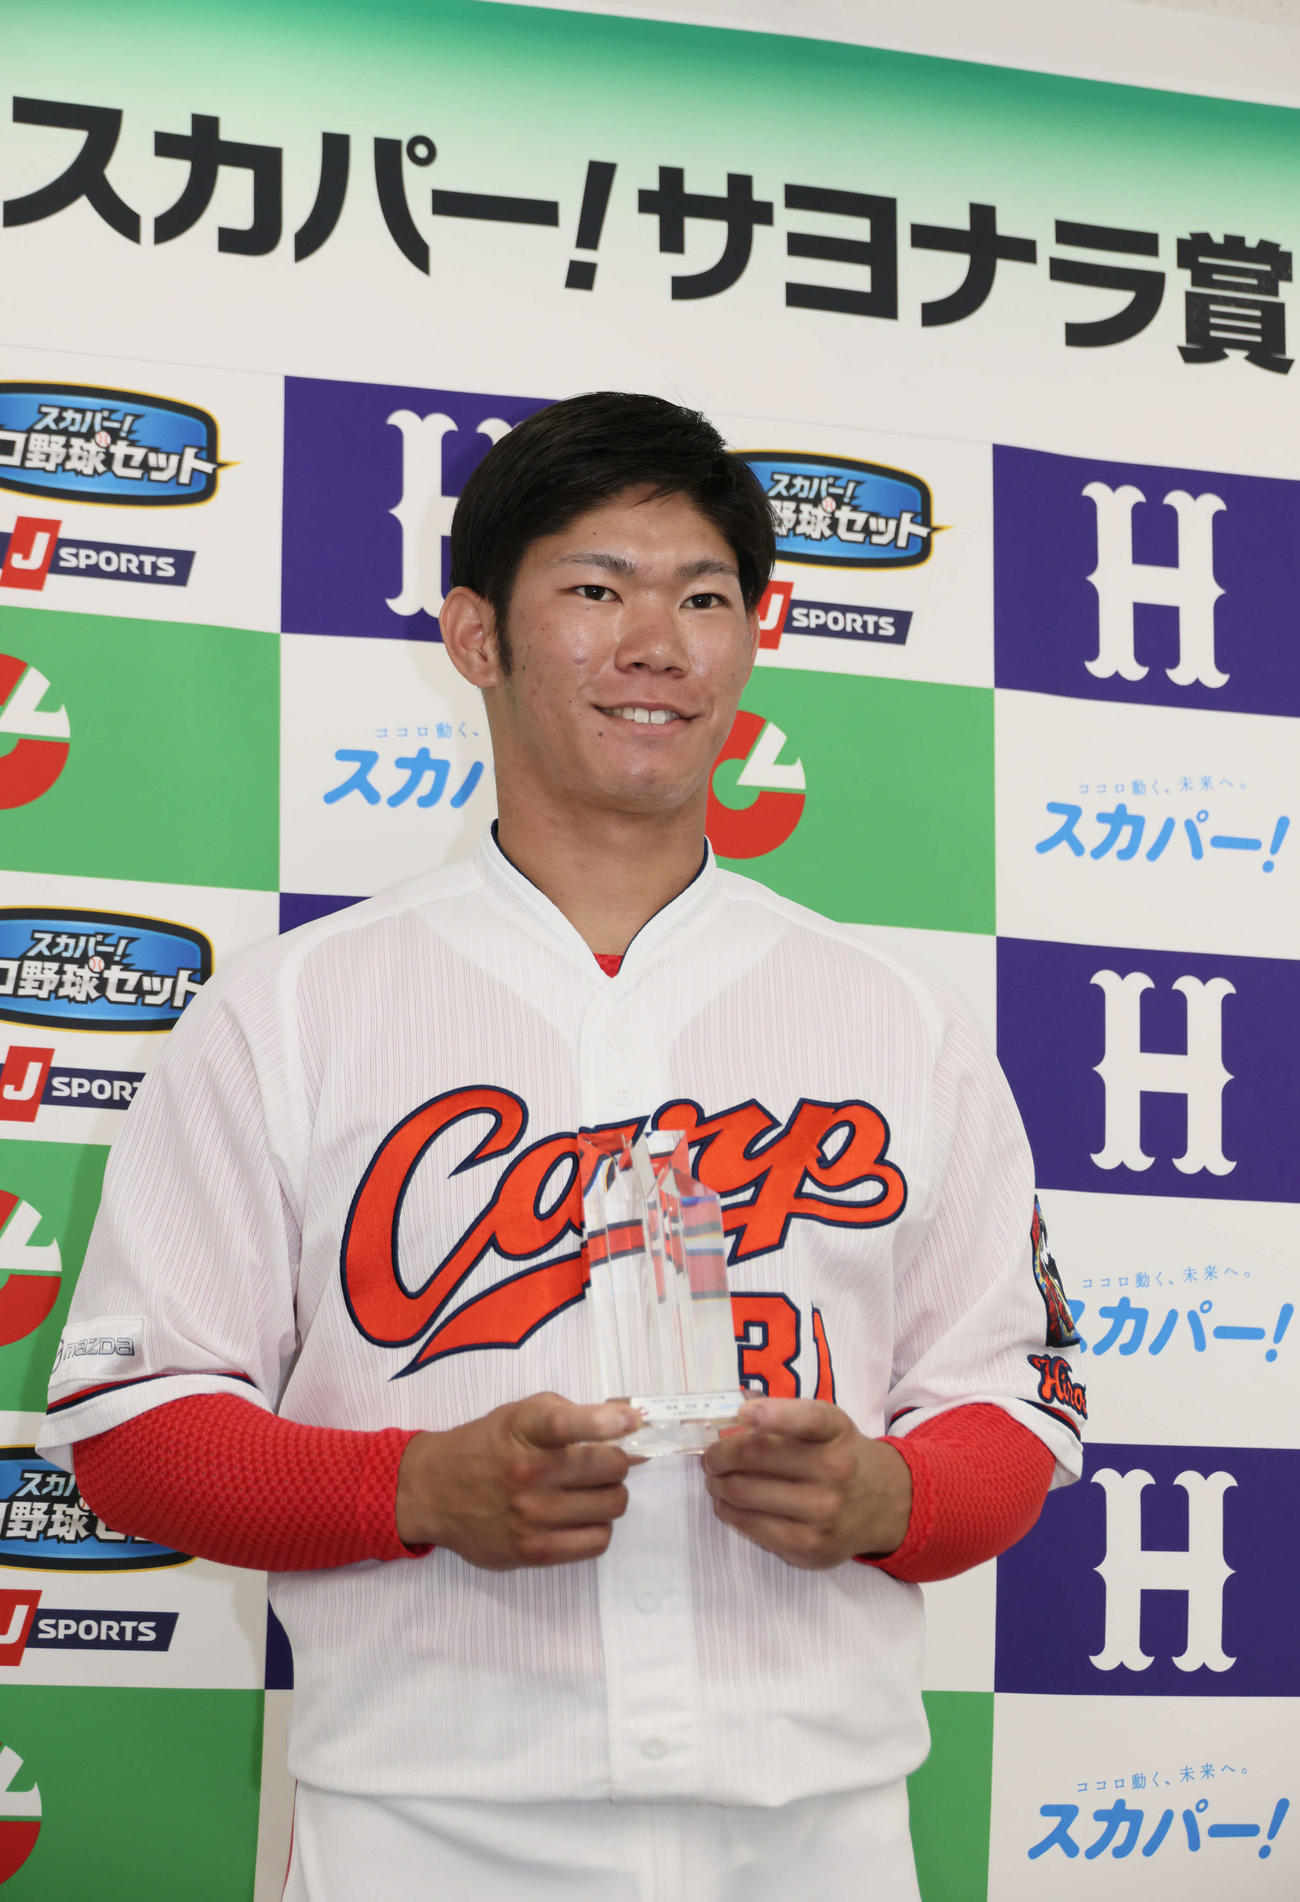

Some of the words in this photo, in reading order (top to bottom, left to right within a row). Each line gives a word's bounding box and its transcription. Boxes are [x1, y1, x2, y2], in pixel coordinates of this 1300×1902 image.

[33, 405, 136, 437] スカパー!
[767, 473, 857, 503] スカパー!
[10, 531, 51, 571] J
[58, 546, 176, 578] SPORTS
[1081, 481, 1231, 688] H
[791, 607, 896, 637] SPORTS
[1035, 801, 1291, 874] スカパー!
[26, 932, 131, 962] スカパー!
[2, 1061, 44, 1101] J
[51, 1076, 143, 1102] SPOR
[1089, 969, 1238, 1176] H
[1088, 1467, 1239, 1673] H
[37, 1617, 157, 1643] SPORTS
[1076, 1761, 1249, 1793] ココロ動く、未来へ。
[1027, 1797, 1291, 1861] スカパー!
